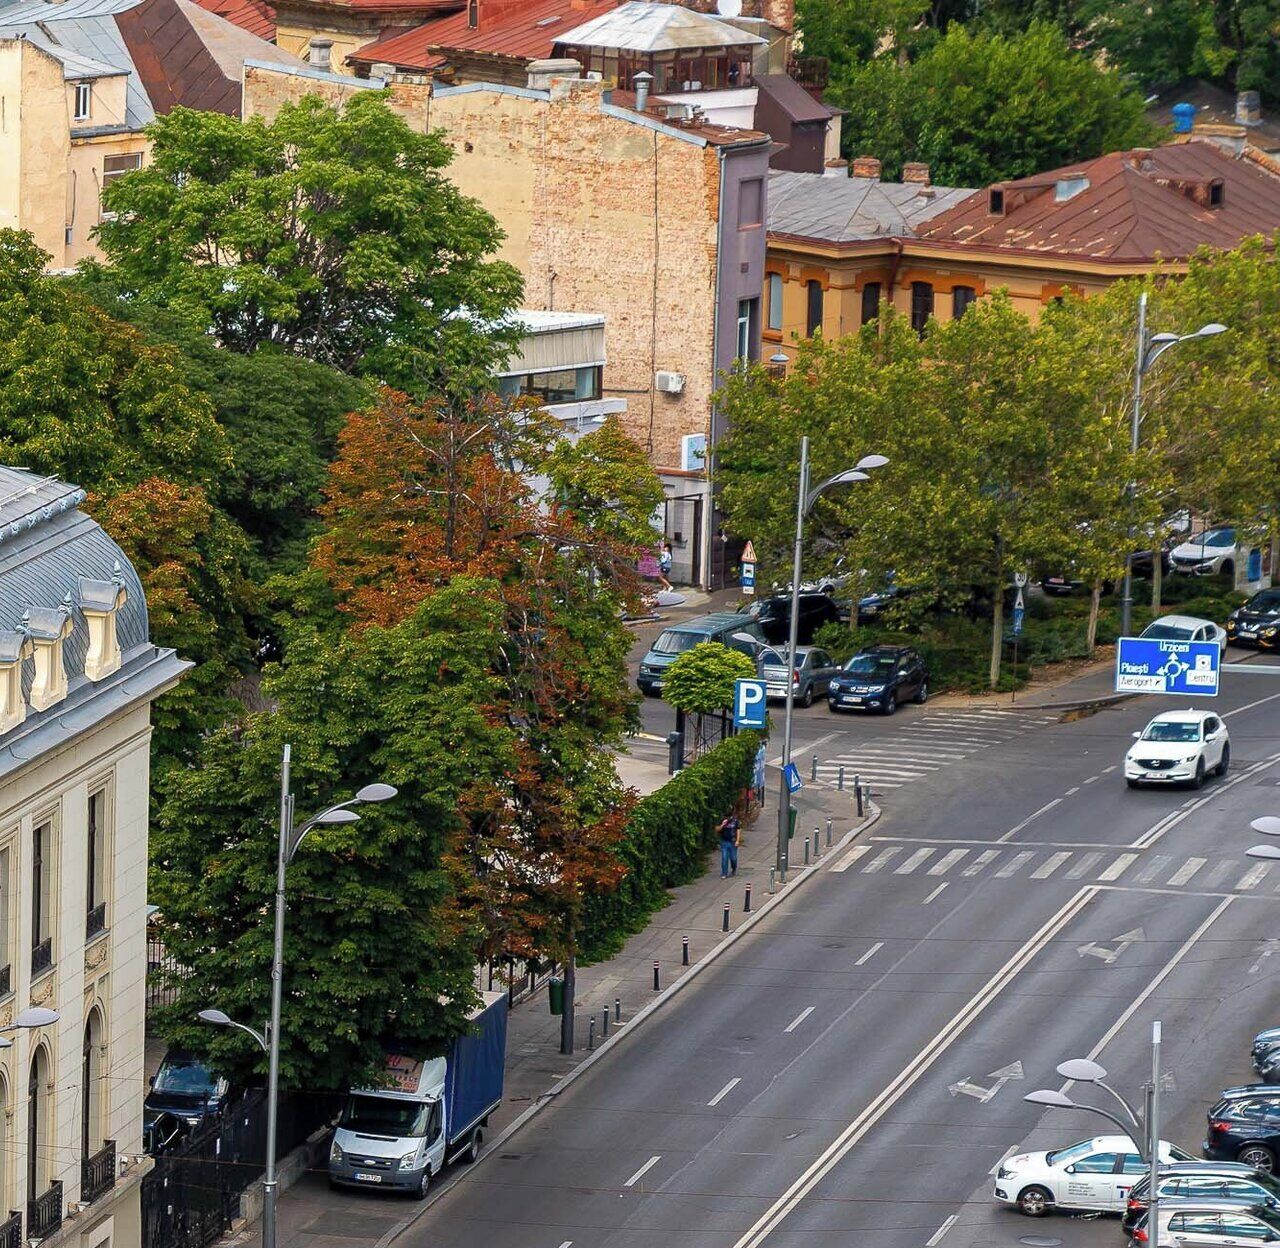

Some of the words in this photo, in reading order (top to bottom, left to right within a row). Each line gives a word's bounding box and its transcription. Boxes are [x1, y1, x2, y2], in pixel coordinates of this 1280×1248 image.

[1159, 641, 1190, 653] Urziceni
[1121, 662, 1149, 675] Ploiești
[1120, 676, 1152, 687] Aeroport
[739, 682, 763, 717] P
